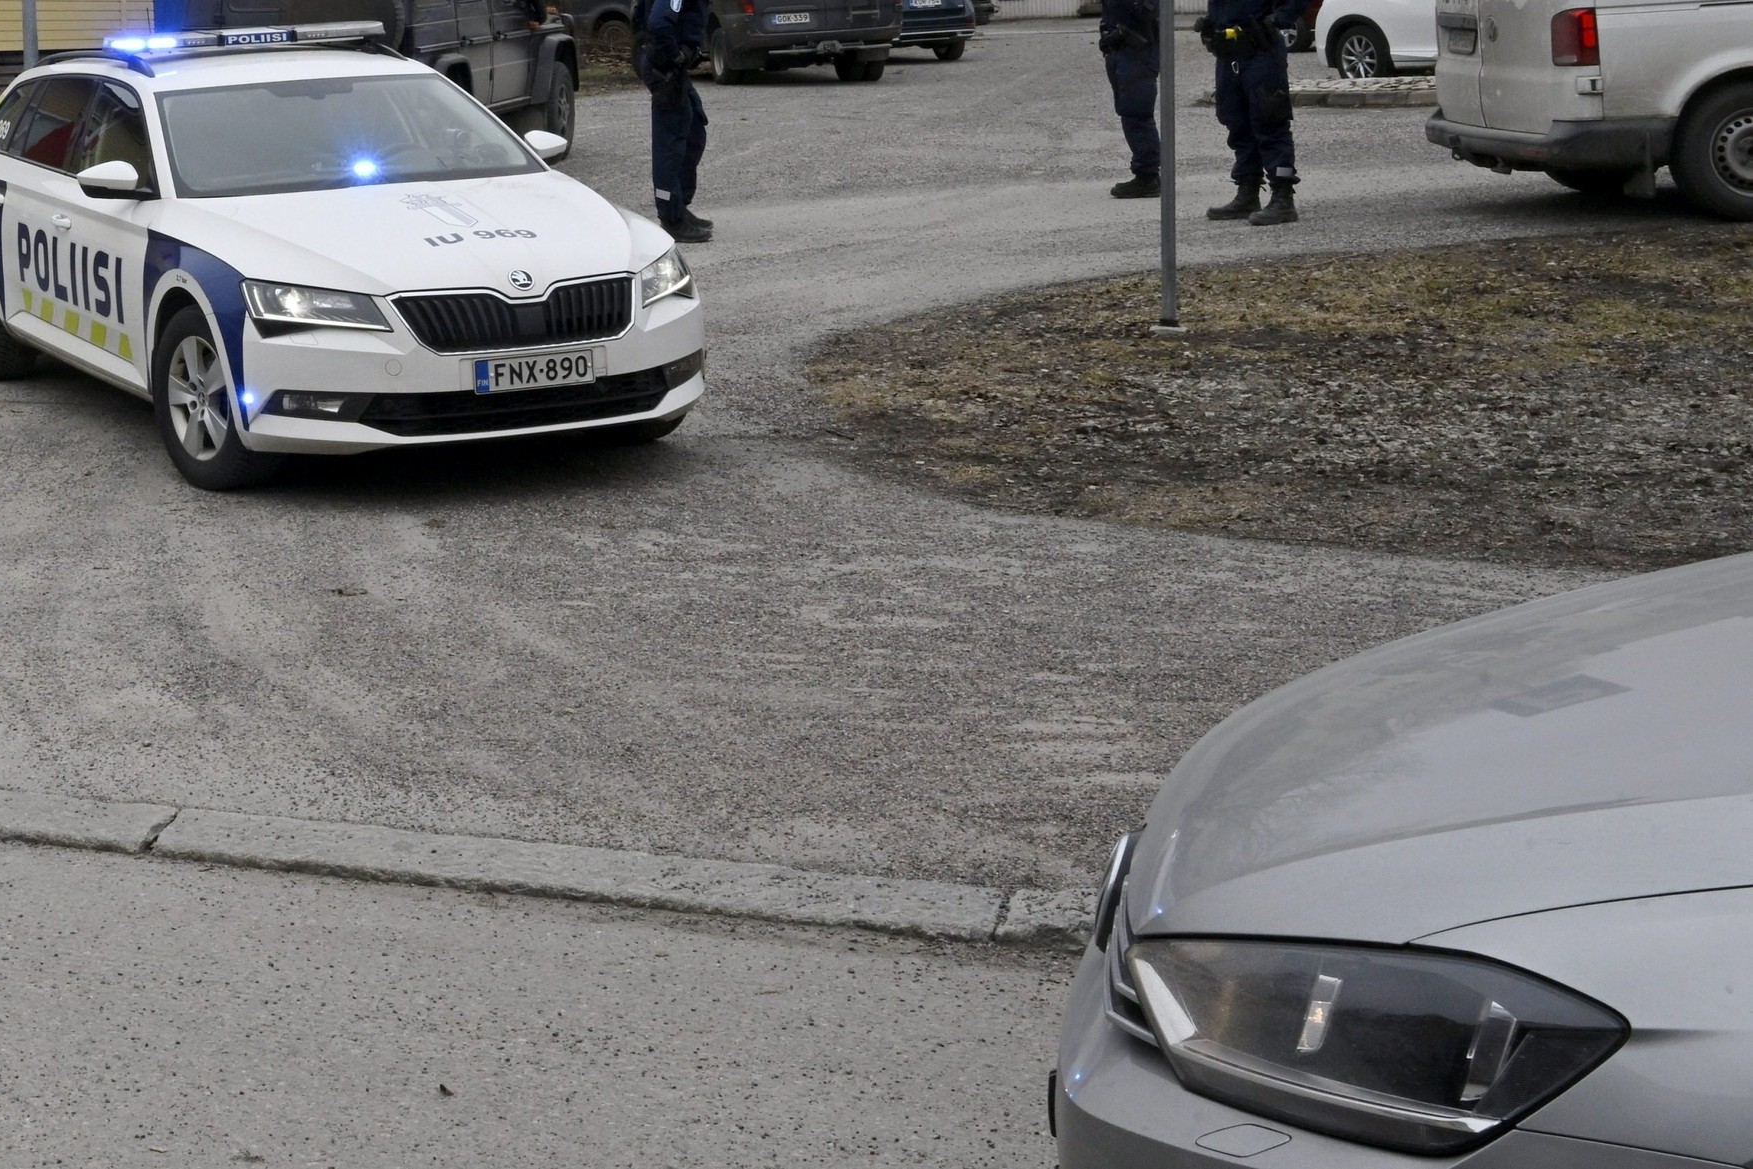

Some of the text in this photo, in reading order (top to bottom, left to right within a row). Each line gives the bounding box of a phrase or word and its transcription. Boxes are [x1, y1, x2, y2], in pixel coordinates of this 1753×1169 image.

[227, 33, 287, 44] POLIISI
[424, 229, 538, 247] IU 969
[17, 221, 125, 325] POLIISI
[477, 378, 489, 387] FIN
